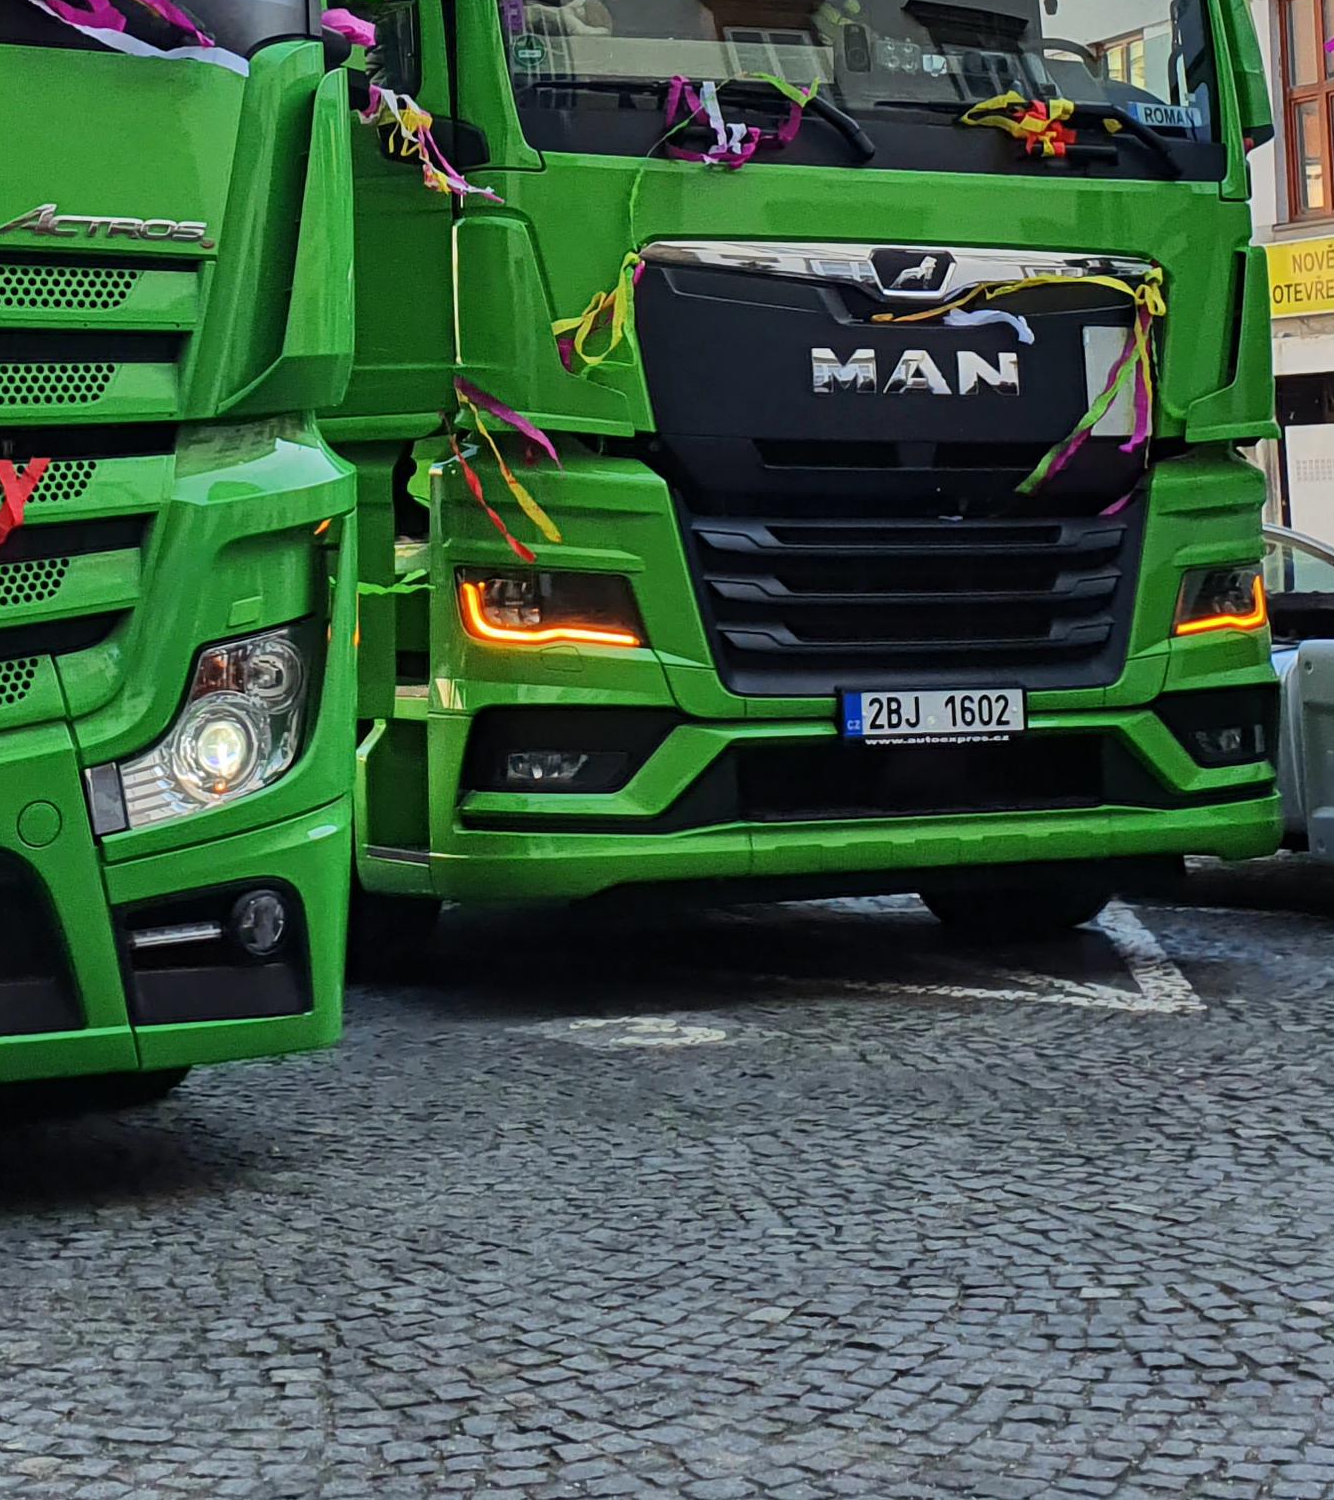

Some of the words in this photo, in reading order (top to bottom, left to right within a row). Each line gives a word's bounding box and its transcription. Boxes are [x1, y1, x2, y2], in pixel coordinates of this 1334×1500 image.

[811, 347, 1020, 395] MAN
[847, 720, 861, 731] CZ
[868, 696, 920, 730] 2BJ
[944, 694, 1011, 728] 1602
[865, 734, 1010, 745] www.autoexpres.cz
